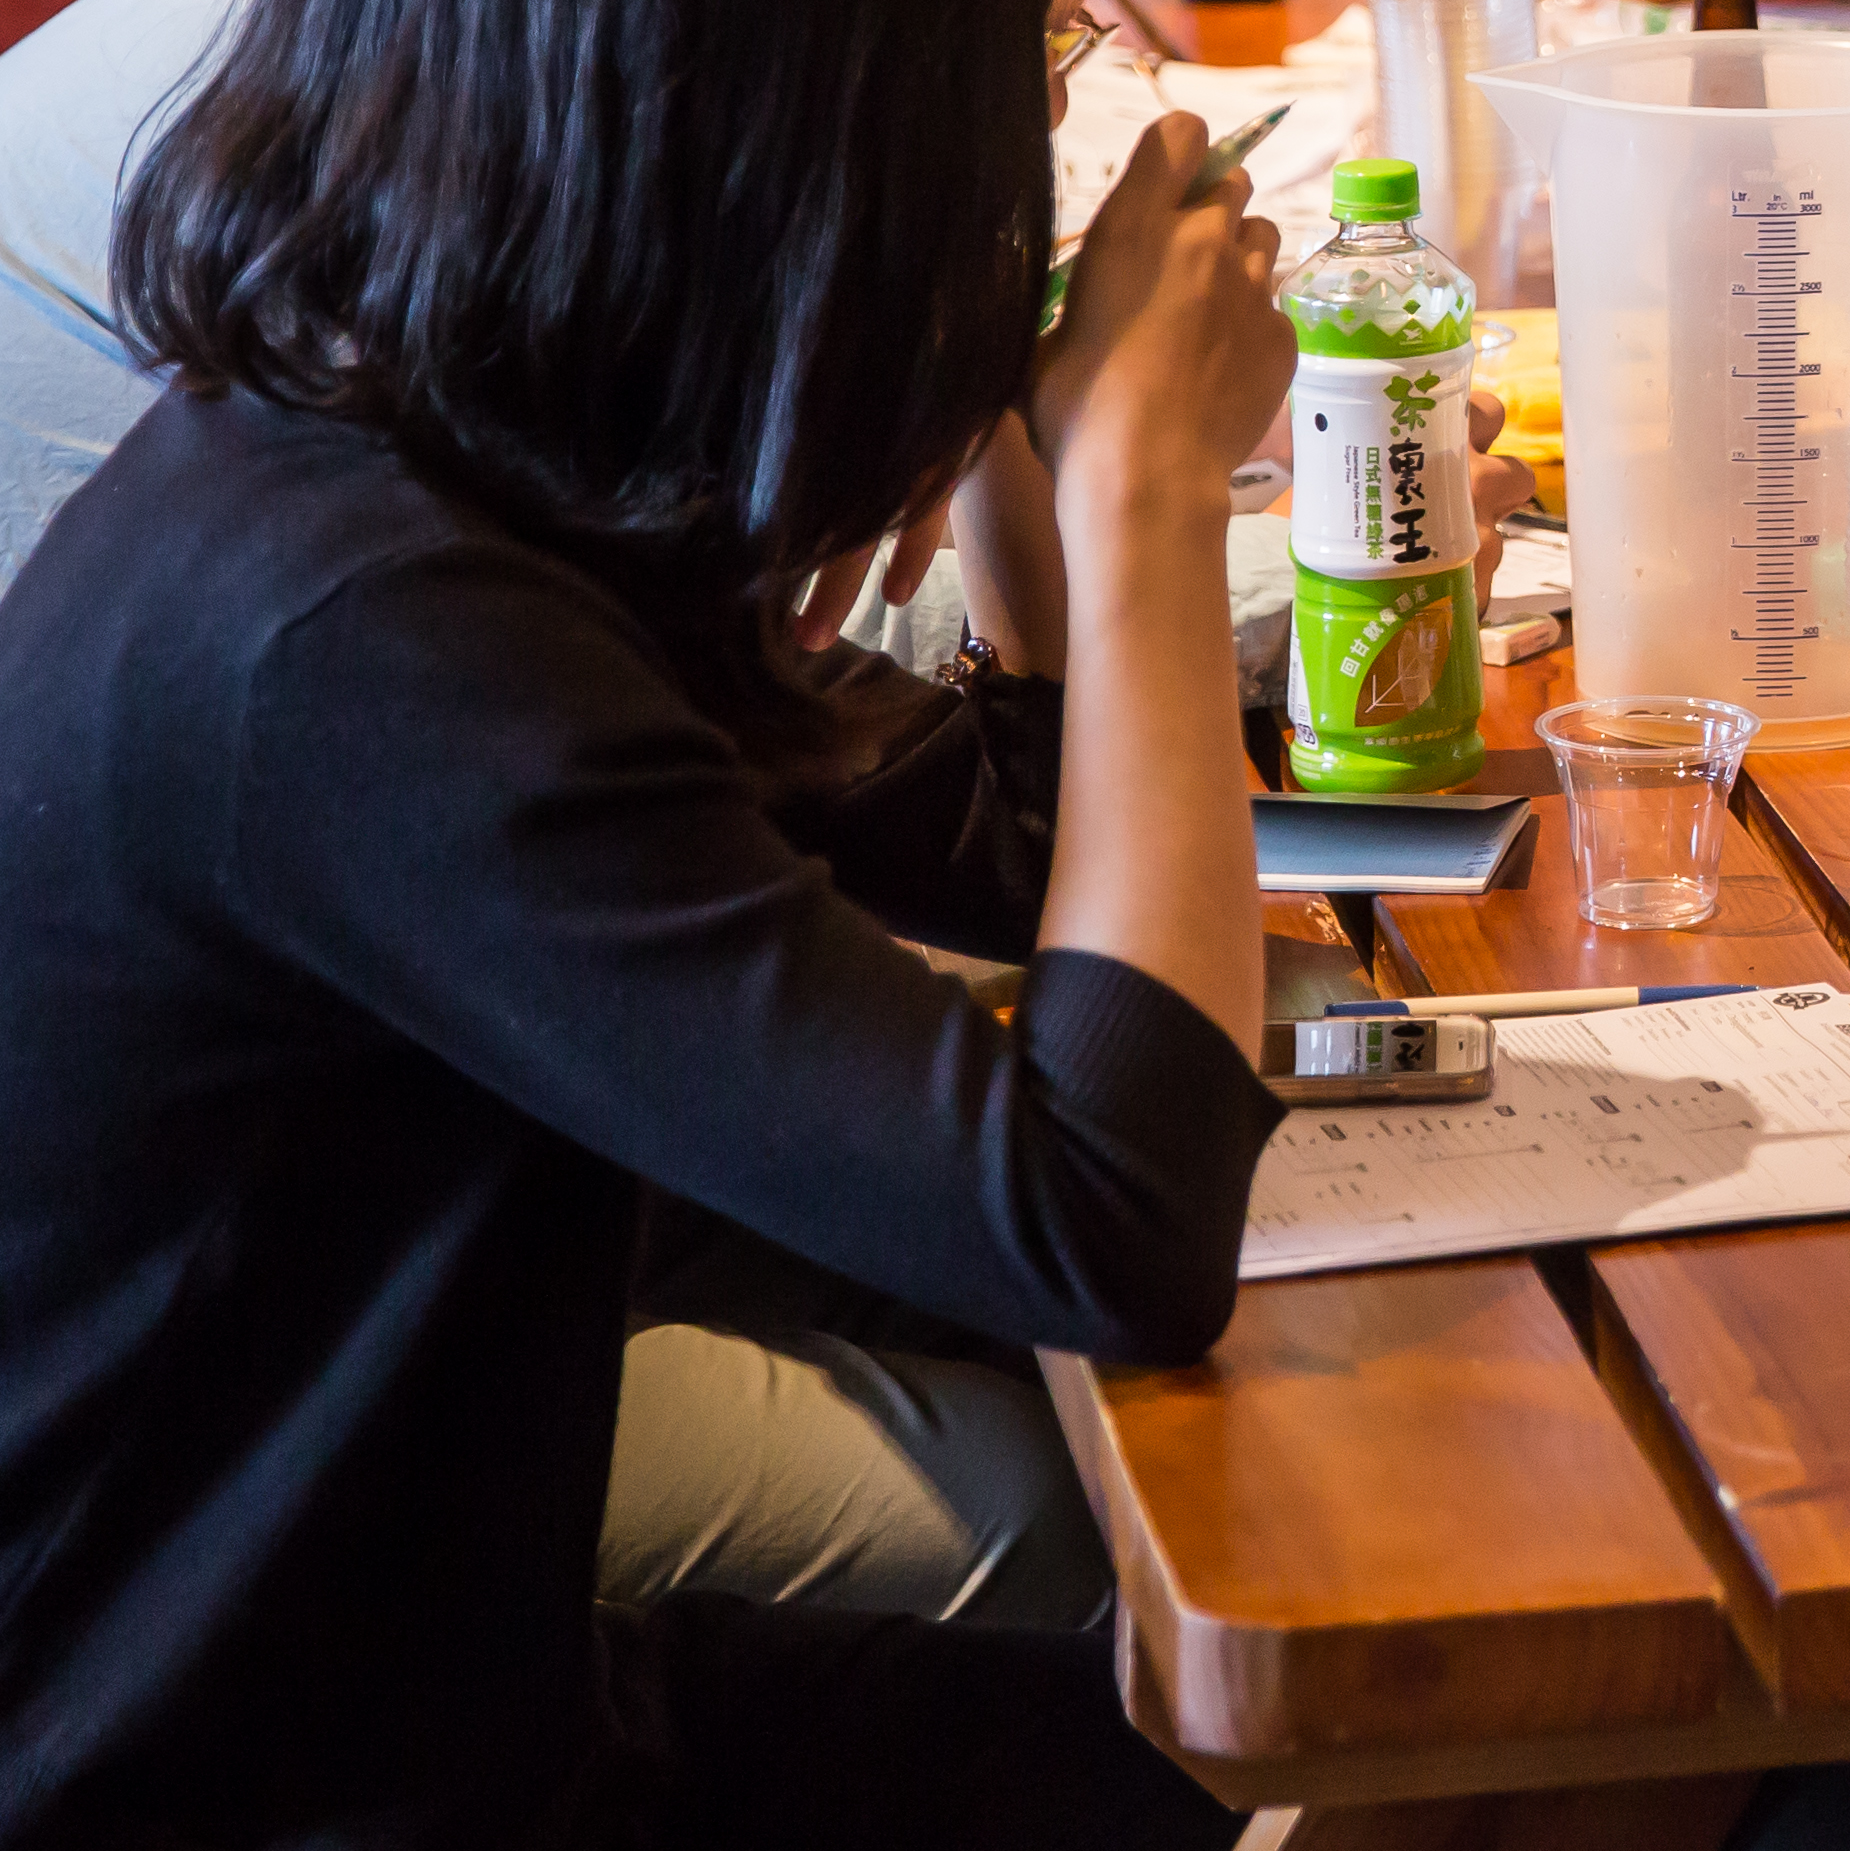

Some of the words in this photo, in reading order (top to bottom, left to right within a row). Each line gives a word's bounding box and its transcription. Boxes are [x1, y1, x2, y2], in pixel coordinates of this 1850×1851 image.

[1799, 190, 1814, 200] ml
[1800, 203, 1822, 213] 3000
[1800, 282, 1822, 291] 2500
[1799, 363, 1821, 373] 2000
[1800, 448, 1821, 457] 1500
[1800, 535, 1820, 543] 1000
[1803, 626, 1819, 636] 500
